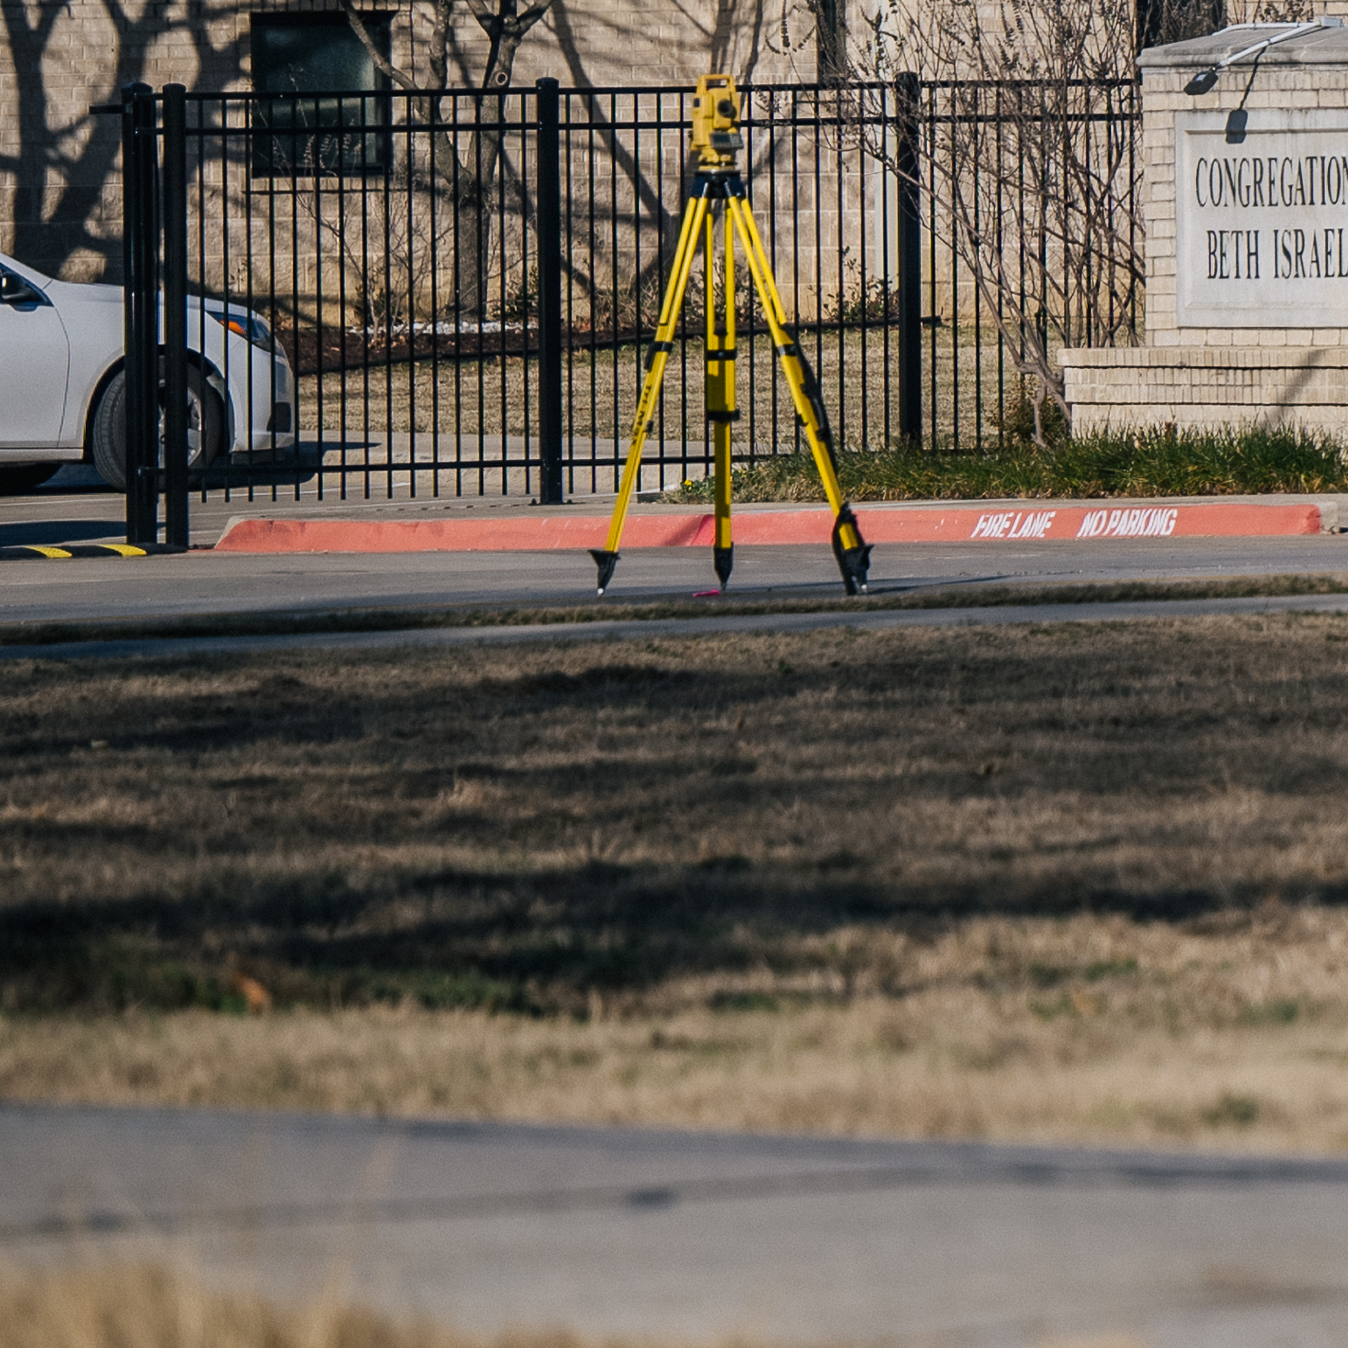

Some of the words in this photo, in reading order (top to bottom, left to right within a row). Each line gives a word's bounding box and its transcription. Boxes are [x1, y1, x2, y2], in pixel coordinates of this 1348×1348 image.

[1206, 229, 1261, 280] BETH
[1273, 228, 1348, 279] ISRAEL
[970, 512, 1014, 538] FIRE
[1007, 511, 1056, 538] LANE
[1076, 510, 1107, 538] NO
[1103, 508, 1178, 537] PARKING
